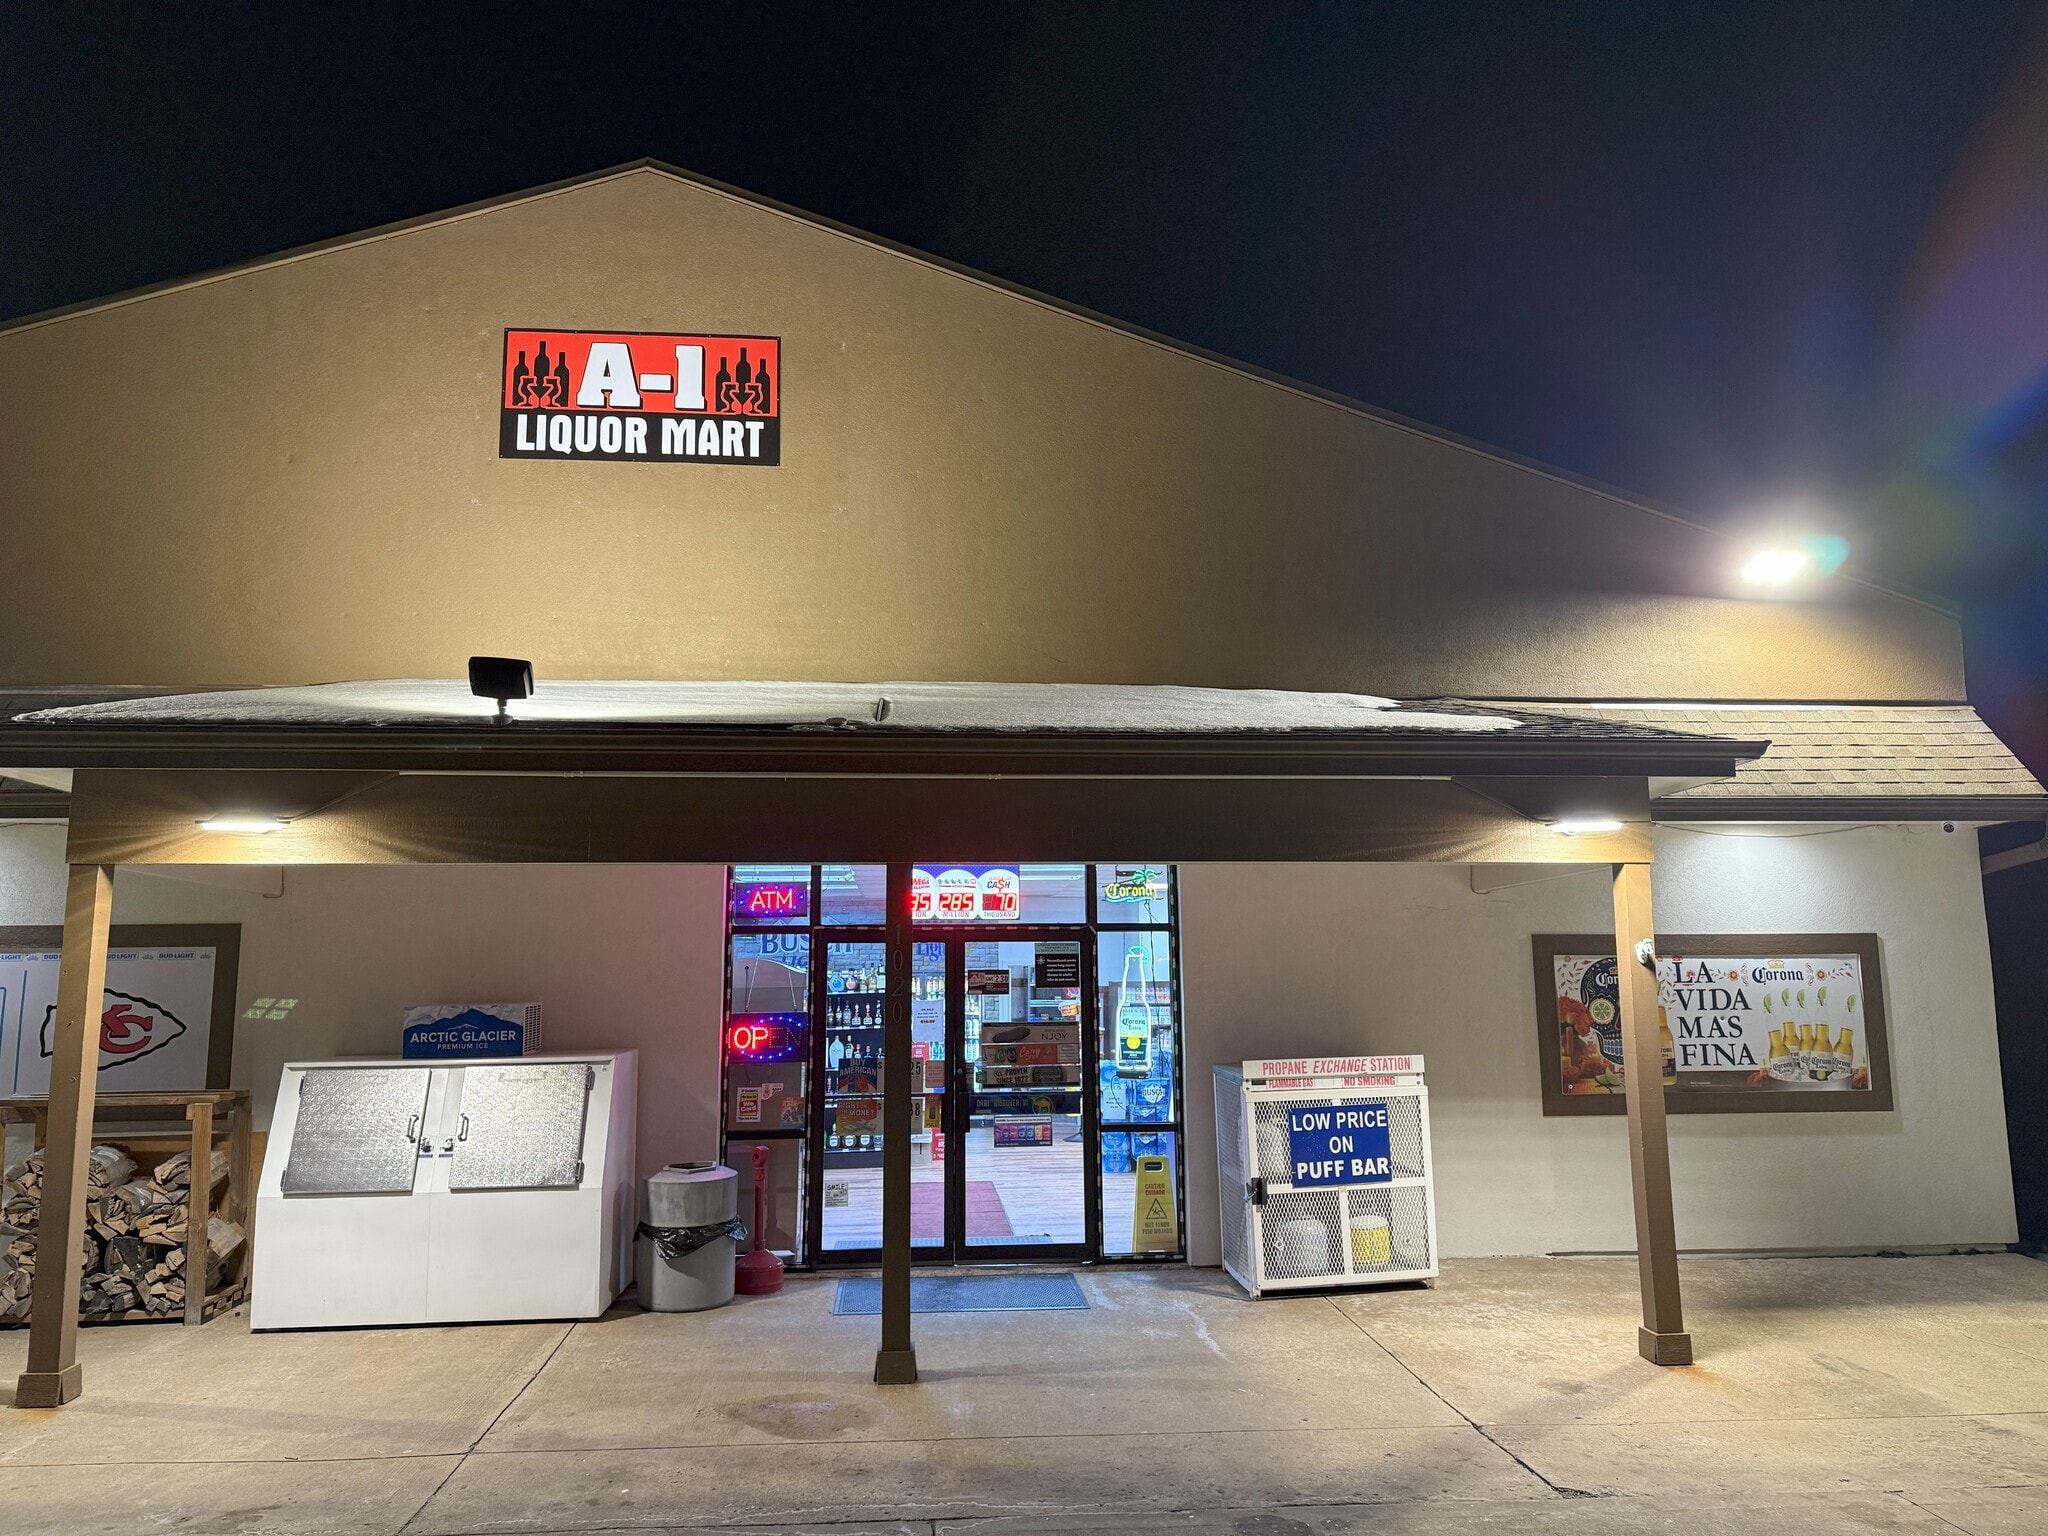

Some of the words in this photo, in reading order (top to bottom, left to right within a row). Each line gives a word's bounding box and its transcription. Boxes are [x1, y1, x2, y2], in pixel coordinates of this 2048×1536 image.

[516, 414, 647, 455] LIQUOR
[661, 418, 764, 457] MART
[751, 891, 793, 909] ATM
[940, 893, 972, 911] 285
[996, 893, 1016, 911] 70
[1595, 973, 1618, 988] Cor
[1672, 961, 1715, 984] LA
[1752, 966, 1804, 985] Corona
[1674, 988, 1752, 1011] VIDA
[1122, 1018, 1145, 1026] Corona
[1677, 1015, 1743, 1038] MAS
[410, 1032, 458, 1043] ARCTIC
[461, 1030, 516, 1042] GLACIER
[1041, 1032, 1068, 1040] NJOY
[1680, 1043, 1759, 1067] FINA
[839, 1066, 876, 1076] AMERICAN
[1262, 1061, 1307, 1076] PROPANE
[1313, 1058, 1367, 1074] EXCHANGE
[1370, 1057, 1411, 1072] STATION
[1269, 1078, 1301, 1088] FLAMMABLE
[1302, 1078, 1313, 1087] GAS
[1344, 1077, 1356, 1086] NO
[1358, 1076, 1395, 1085] SMOKING
[1142, 1088, 1165, 1096] BUSCH
[1292, 1113, 1330, 1131] LOW
[1336, 1110, 1387, 1129] PRICE
[1329, 1136, 1353, 1154] ON
[1297, 1160, 1344, 1179] PUFF
[1352, 1157, 1390, 1176] BAR
